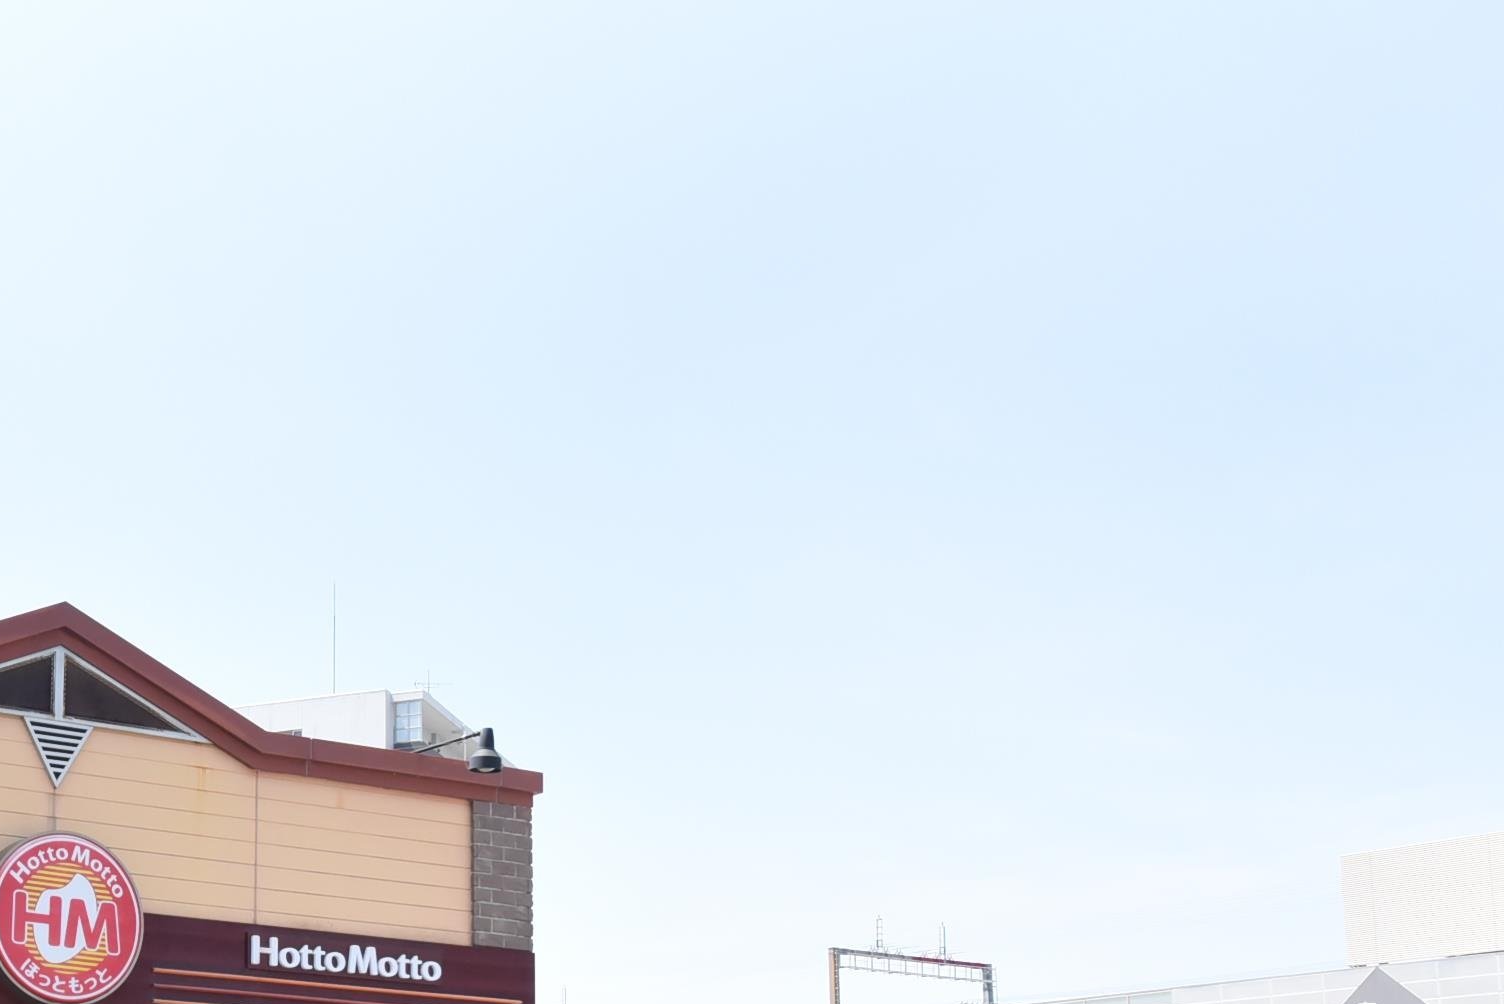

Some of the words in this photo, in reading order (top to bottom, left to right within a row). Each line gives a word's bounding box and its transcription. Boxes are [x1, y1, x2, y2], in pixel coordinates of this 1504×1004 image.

[12, 889, 121, 956] HM
[20, 957, 113, 994] ほっともっと
